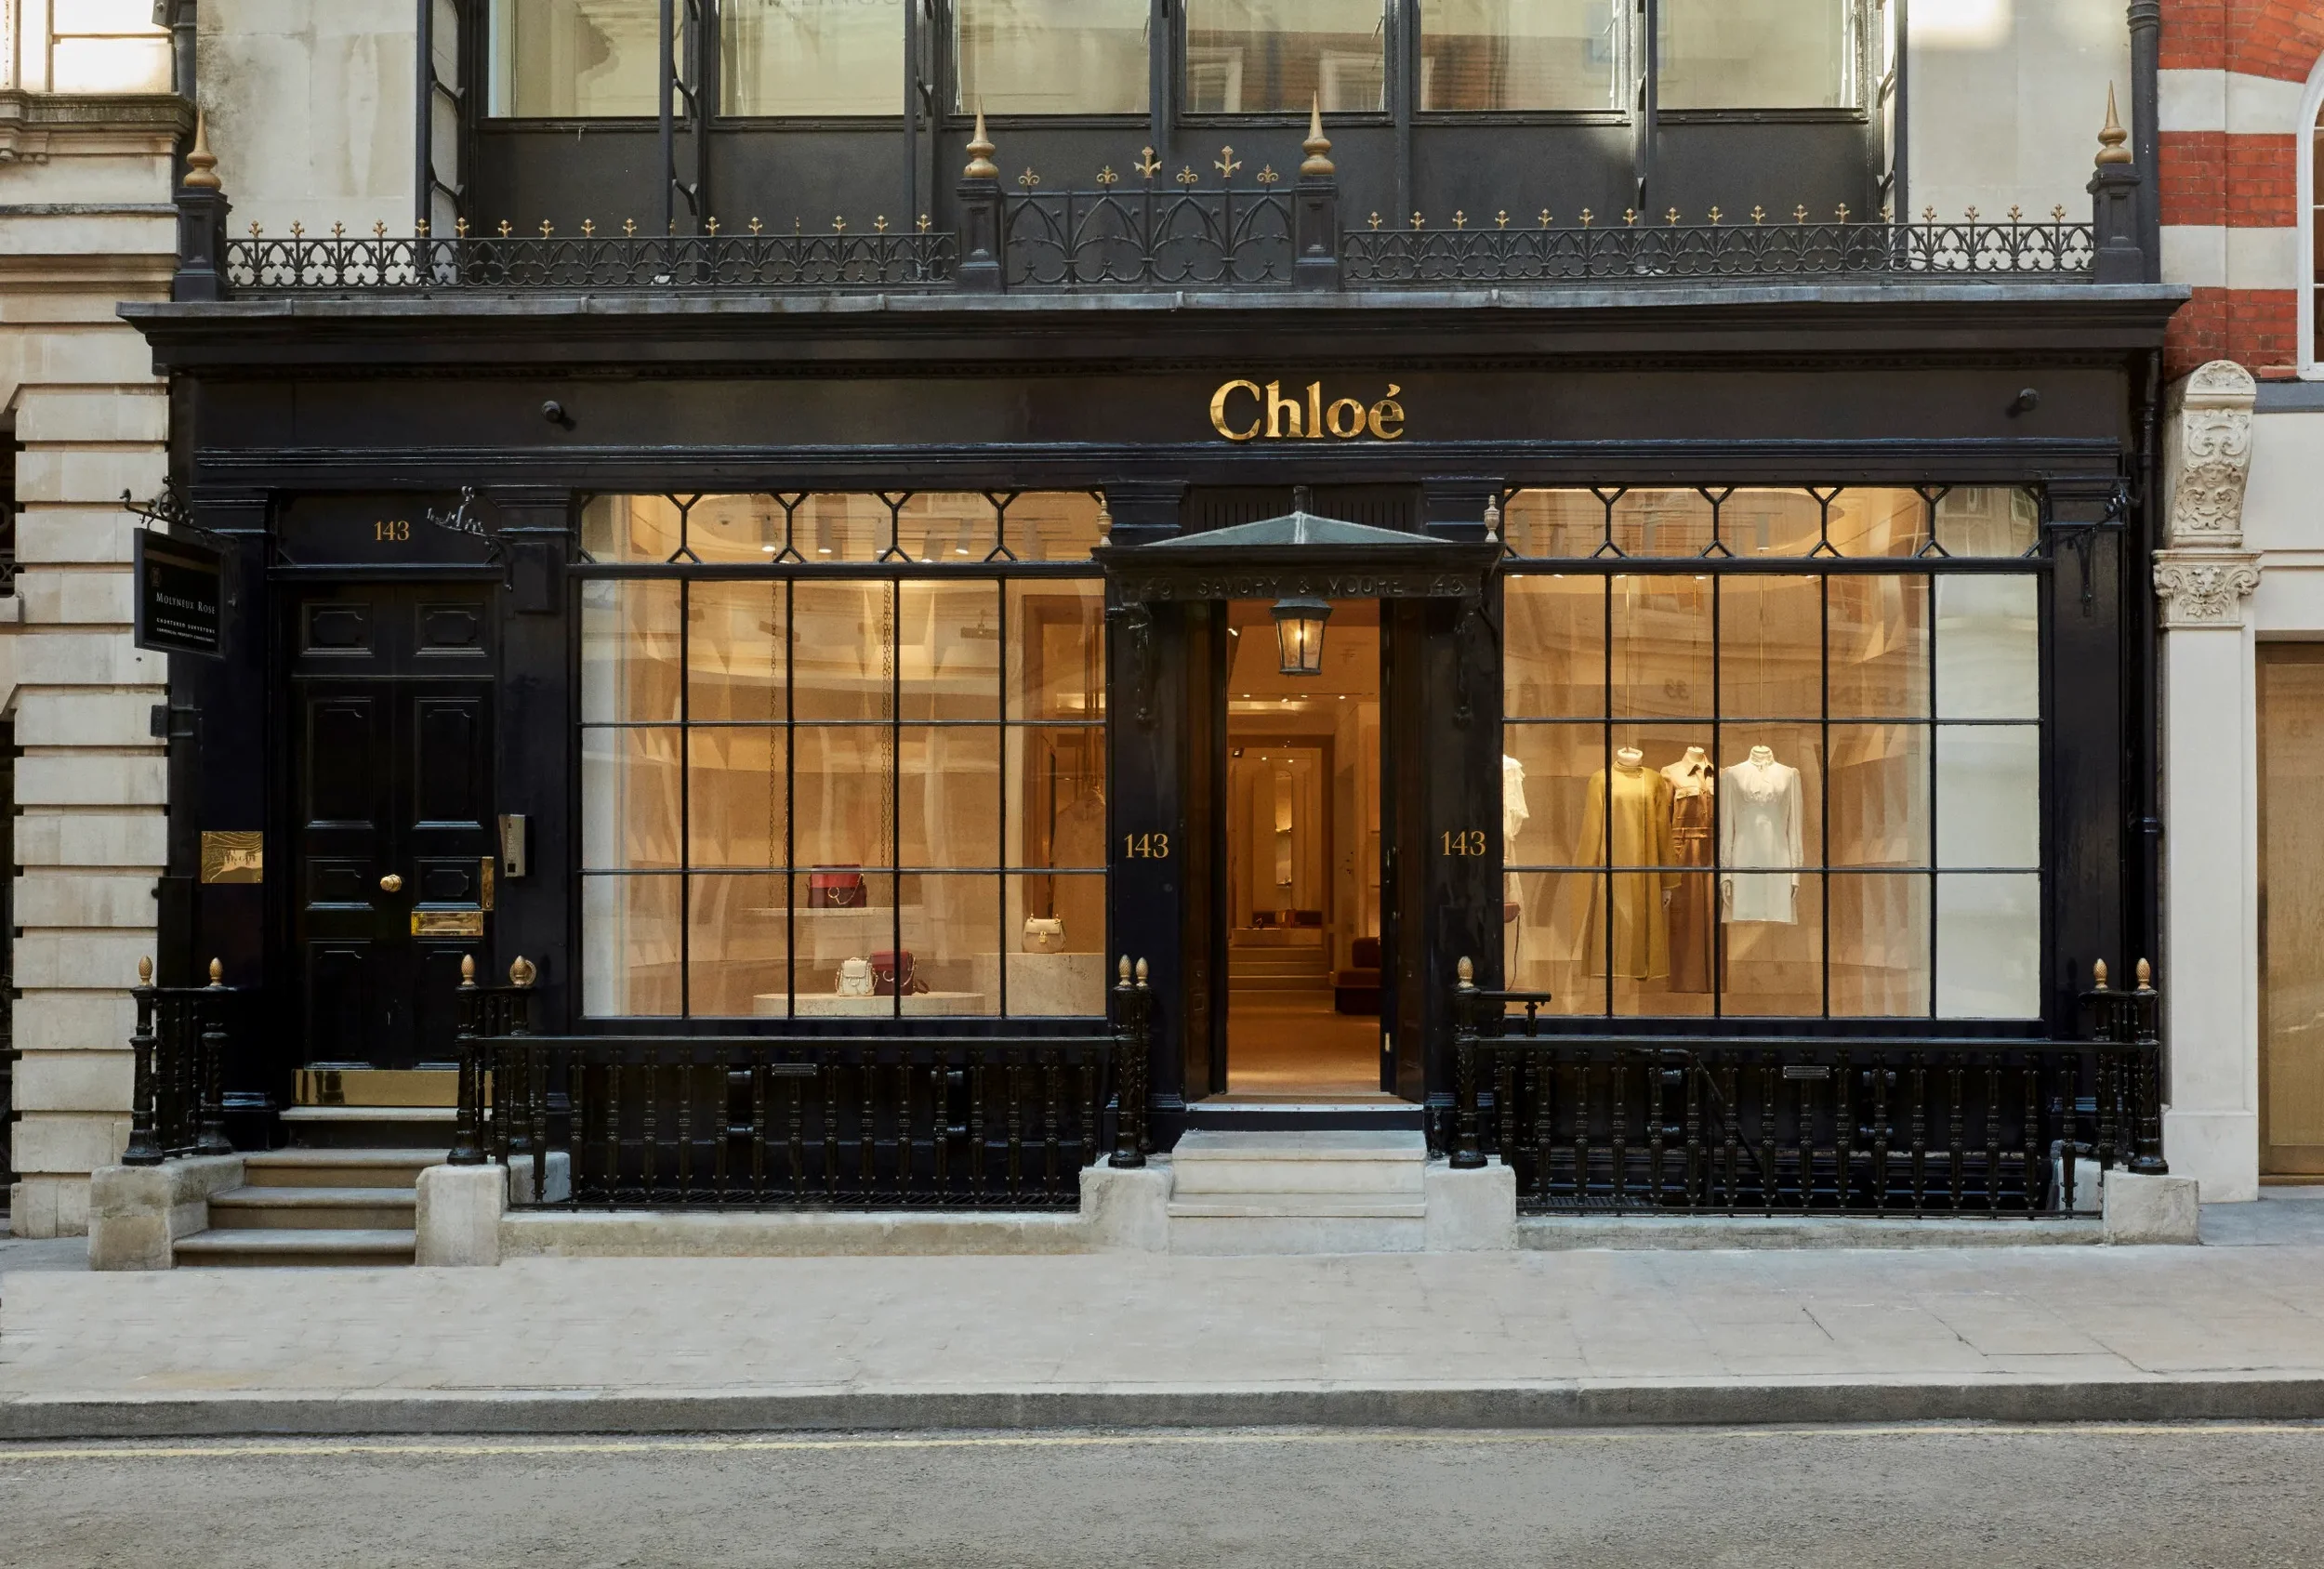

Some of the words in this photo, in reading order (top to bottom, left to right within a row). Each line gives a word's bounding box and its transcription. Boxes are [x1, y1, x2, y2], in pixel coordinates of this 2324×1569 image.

[1209, 379, 1405, 441] Chloé
[375, 521, 410, 540] 143
[1124, 833, 1169, 859] 143
[1440, 830, 1486, 856] 143
